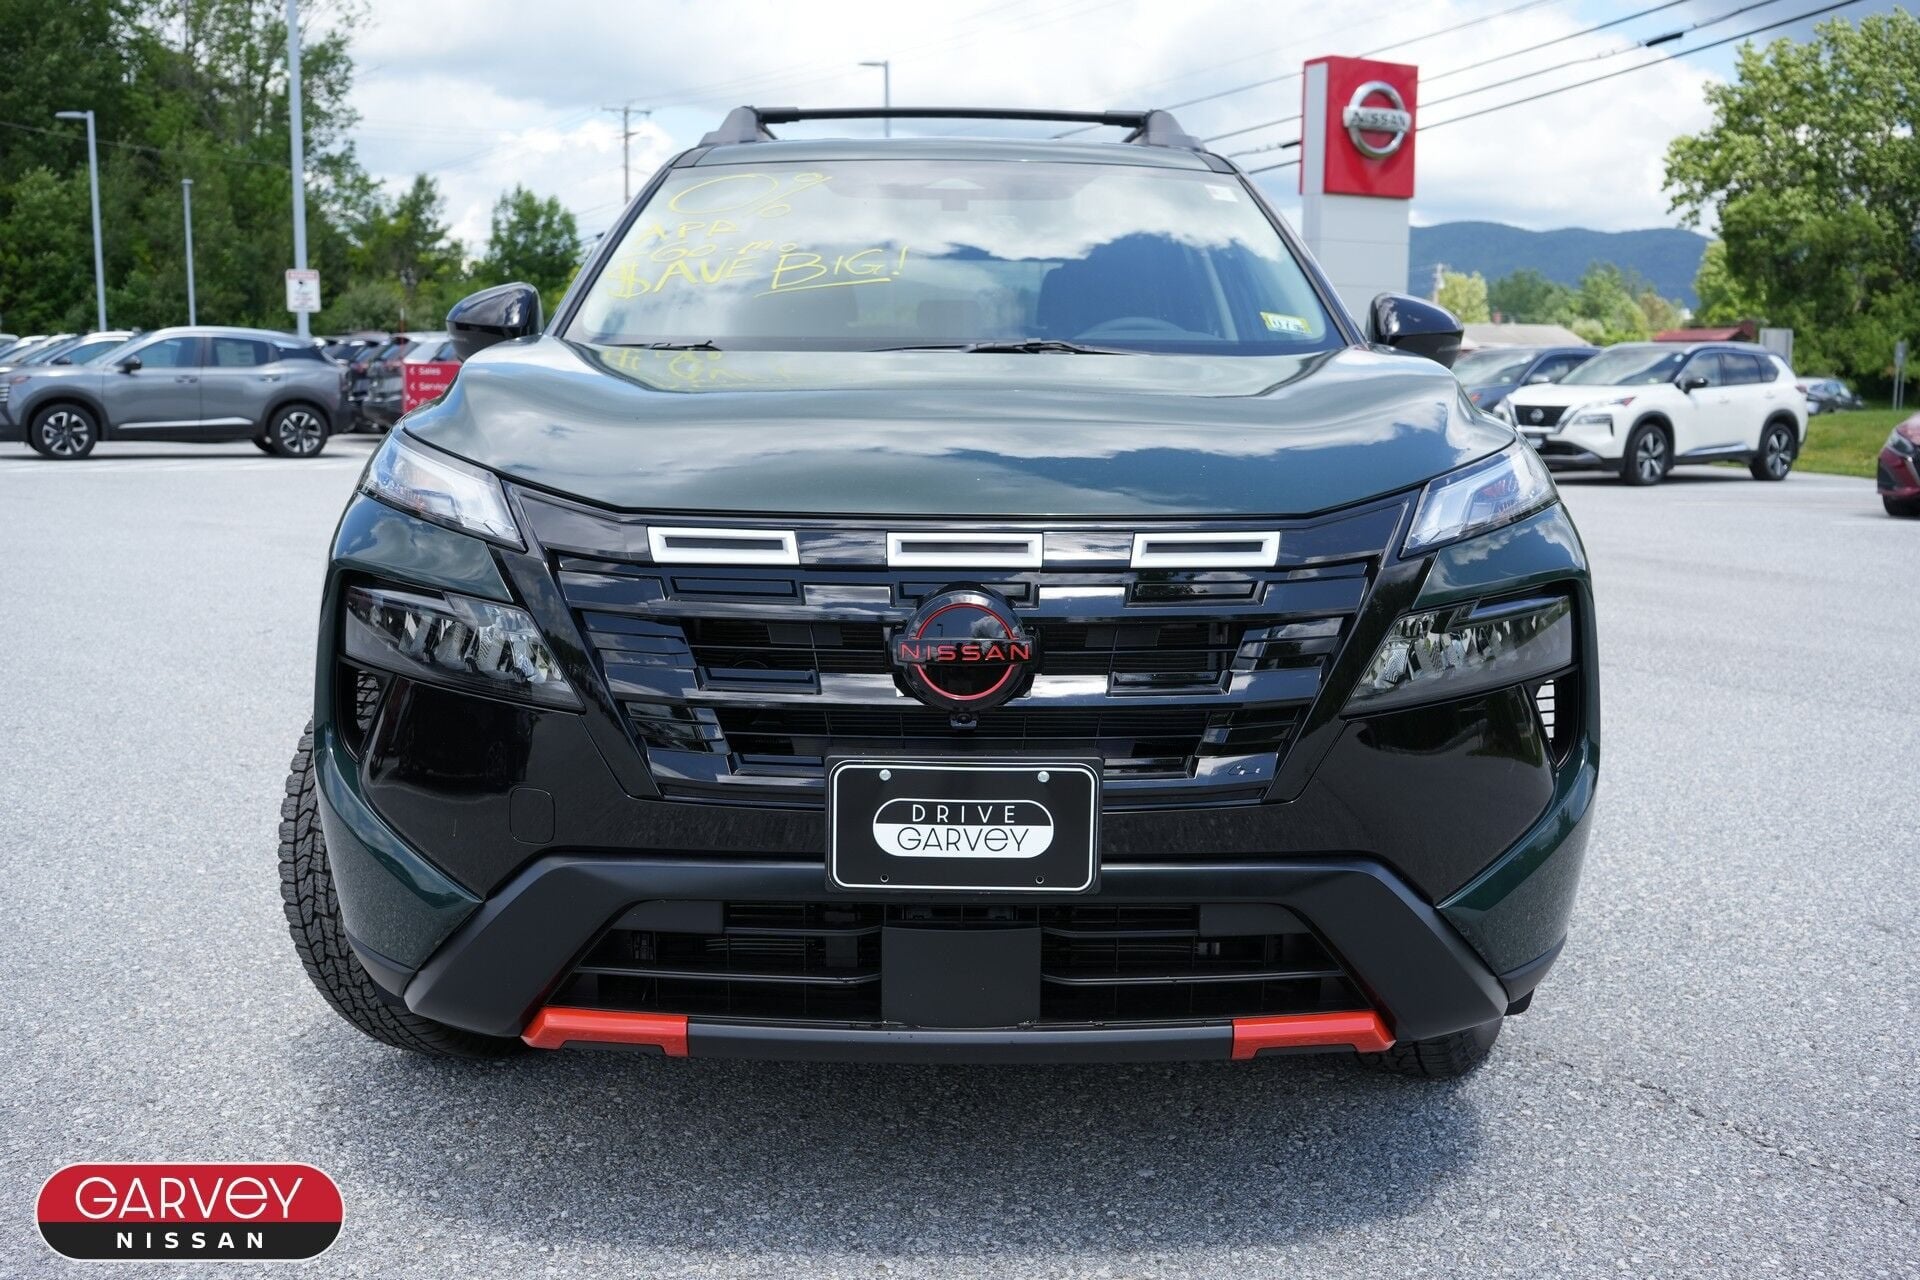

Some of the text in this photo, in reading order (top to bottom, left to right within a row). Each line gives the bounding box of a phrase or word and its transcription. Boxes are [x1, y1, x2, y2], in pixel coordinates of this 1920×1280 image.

[1351, 111, 1407, 127] NISSAN
[772, 246, 908, 290] BIG!
[418, 367, 441, 375] Sales
[900, 643, 1032, 662] NISSAN
[912, 804, 1016, 824] DRIVE
